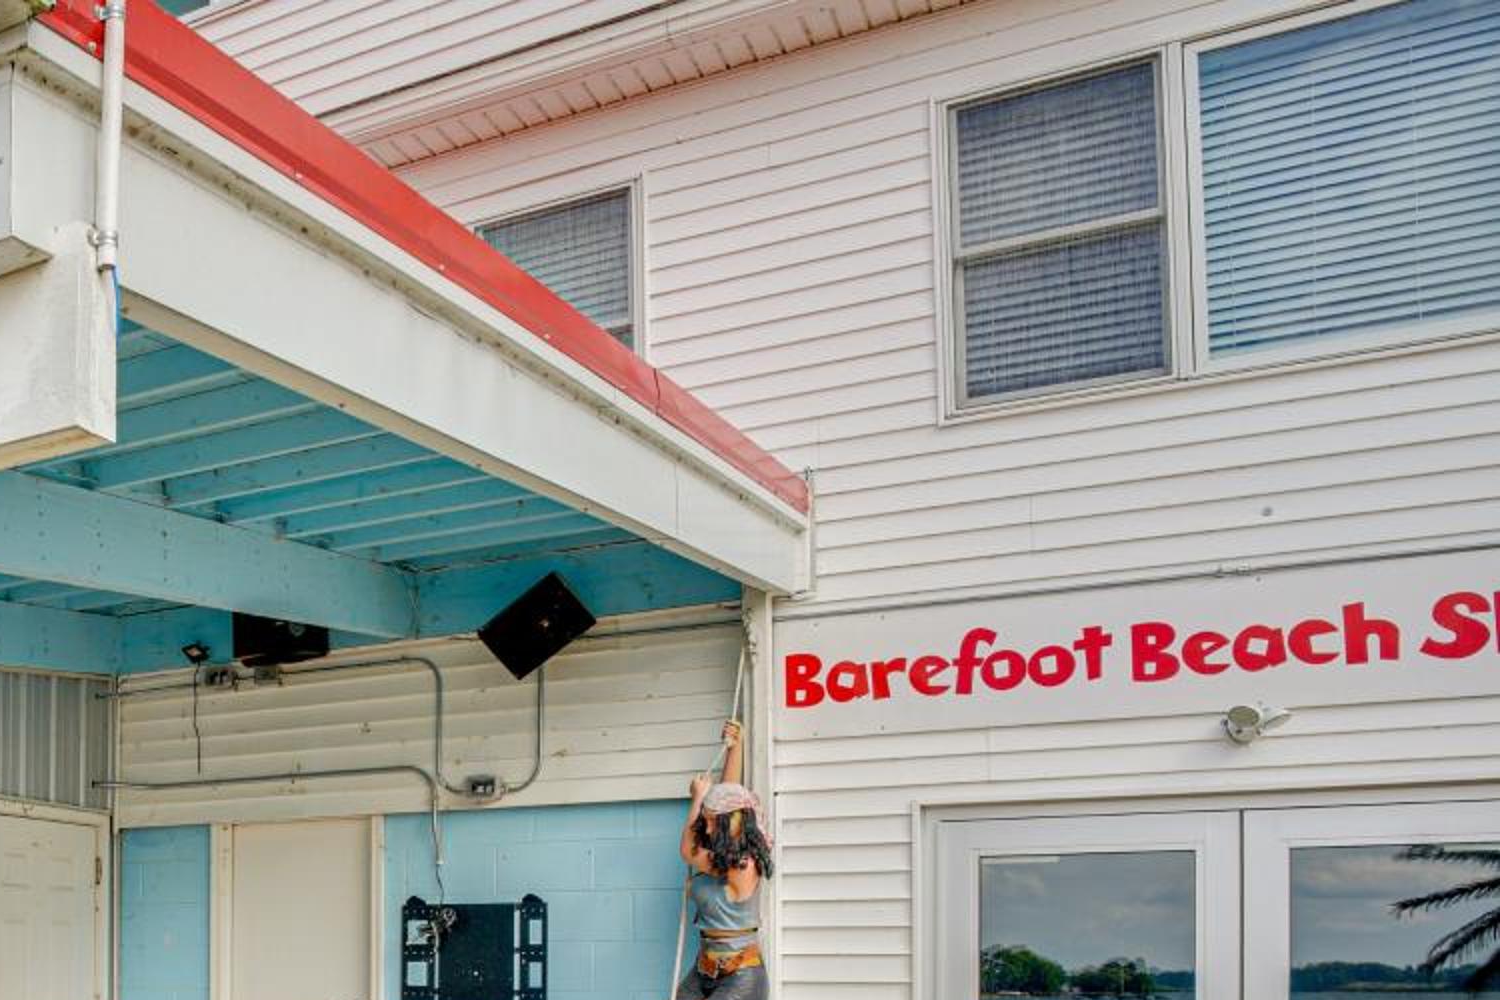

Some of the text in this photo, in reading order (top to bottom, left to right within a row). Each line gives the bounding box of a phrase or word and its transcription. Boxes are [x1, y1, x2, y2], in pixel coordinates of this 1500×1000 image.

[784, 591, 1500, 709] Barefoot Beach S
